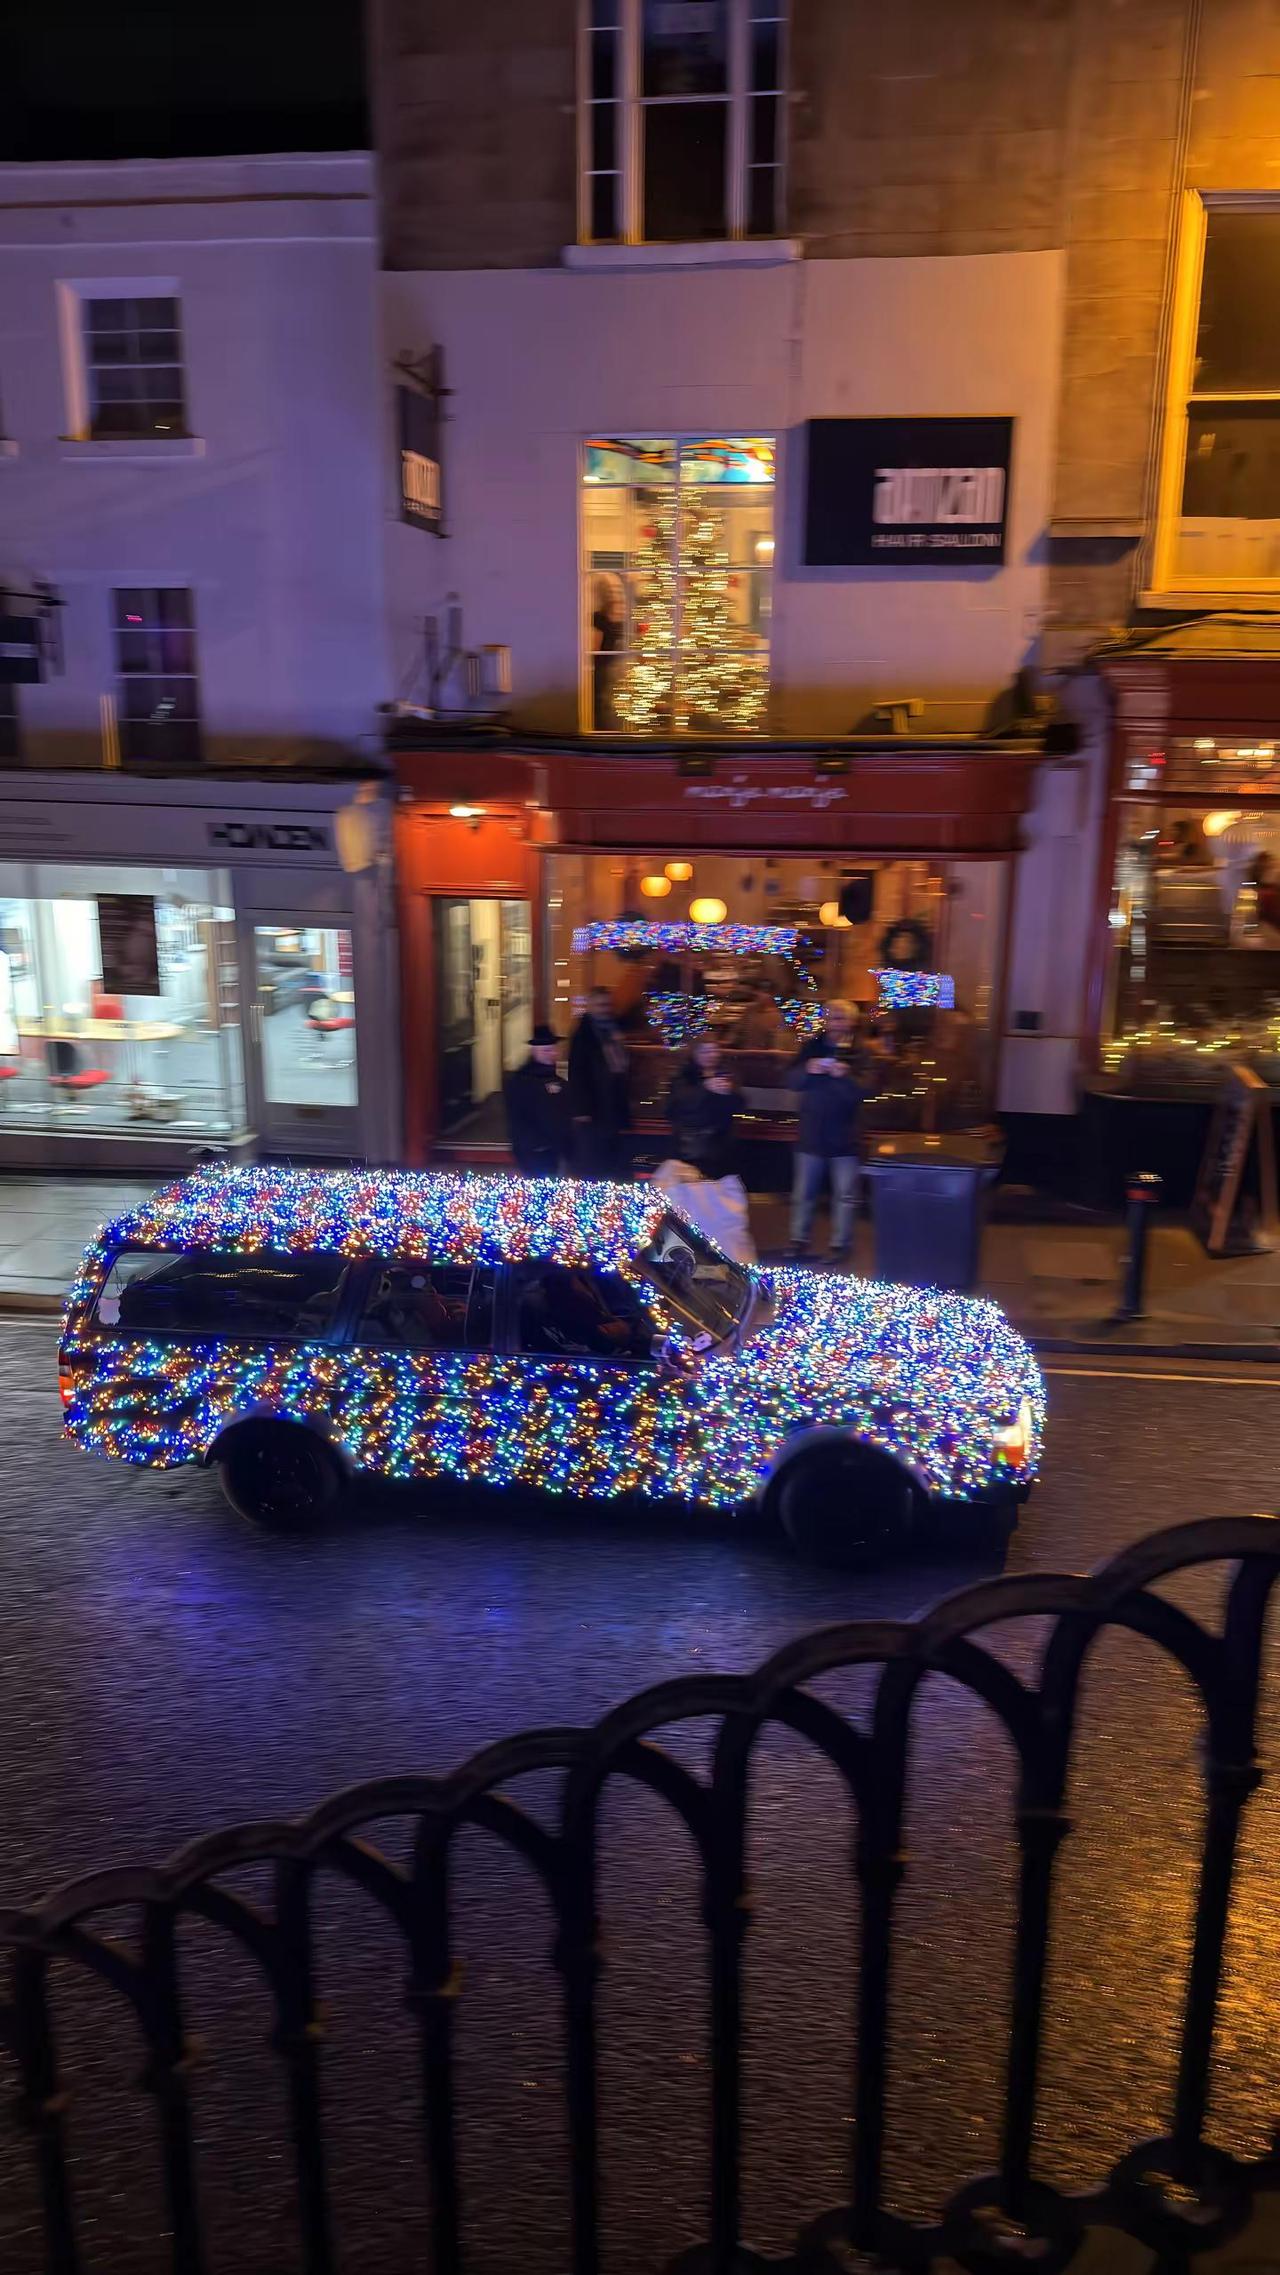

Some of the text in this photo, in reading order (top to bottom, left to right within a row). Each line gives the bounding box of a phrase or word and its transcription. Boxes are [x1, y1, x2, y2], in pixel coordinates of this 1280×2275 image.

[872, 533, 1001, 548] HAIR SALON
[207, 823, 330, 850] HOWDEN
